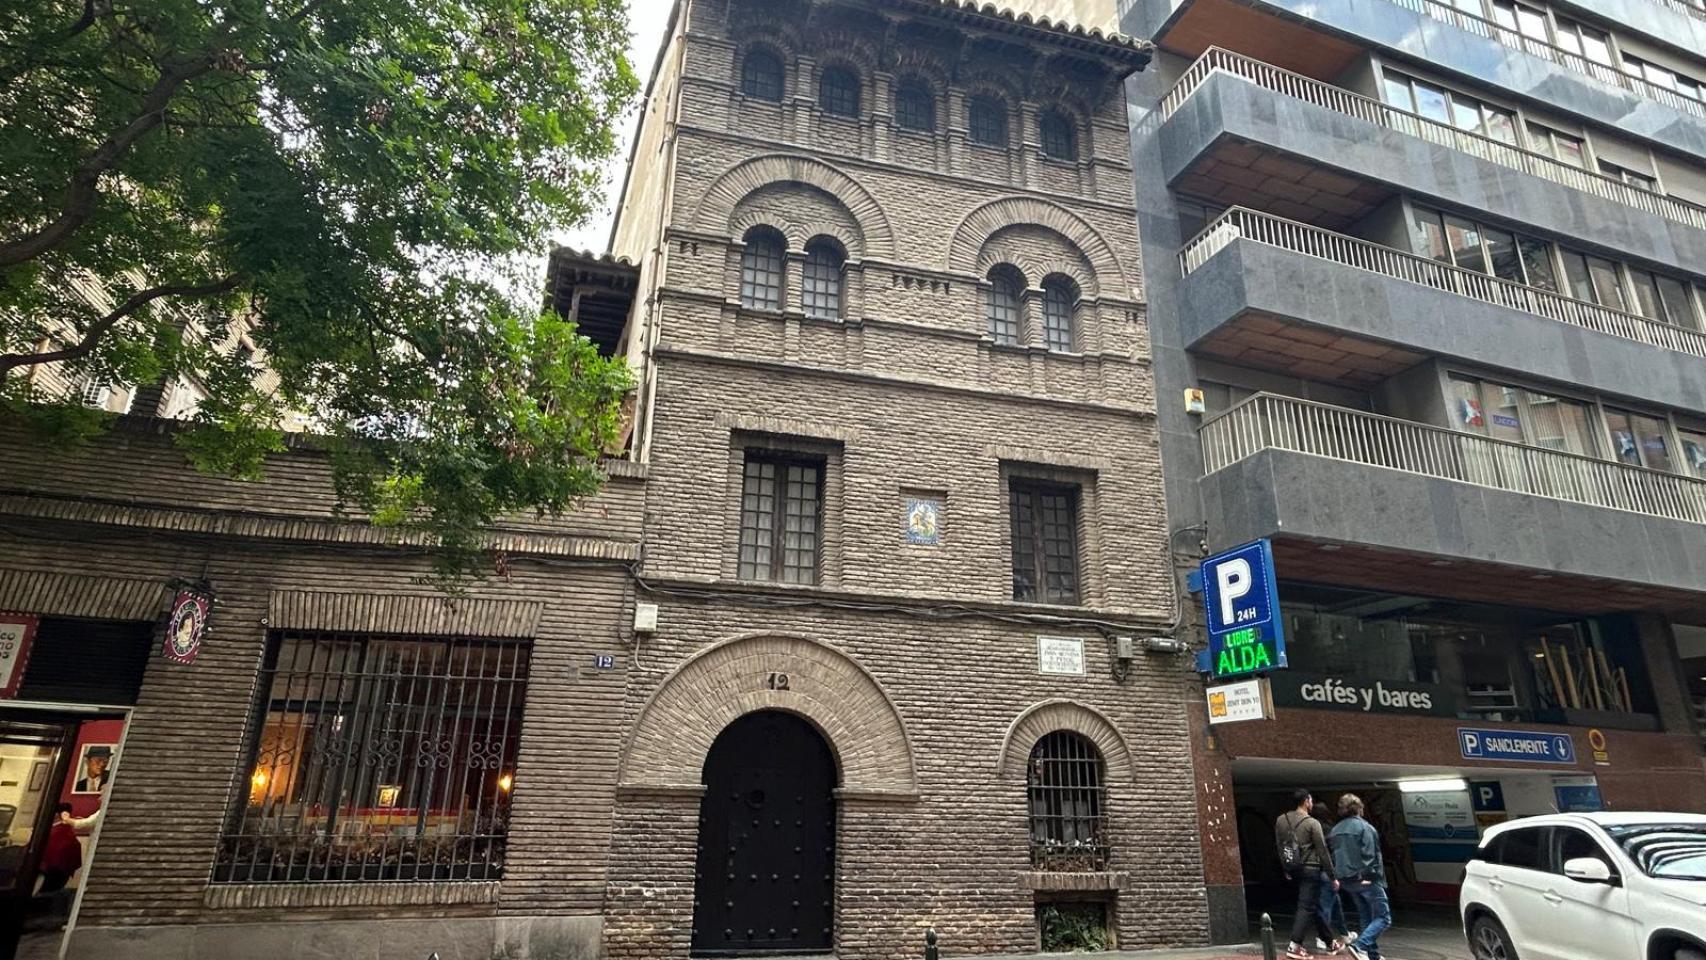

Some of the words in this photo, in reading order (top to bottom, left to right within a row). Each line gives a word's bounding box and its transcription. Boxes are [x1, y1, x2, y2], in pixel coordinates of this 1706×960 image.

[1215, 557, 1252, 626] P
[1237, 606, 1257, 623] 24H
[1225, 627, 1255, 648] LIBRE
[598, 655, 612, 667] 12
[1218, 642, 1271, 674] ALDA
[767, 672, 790, 691] 12
[1300, 678, 1358, 704] cafés
[1359, 687, 1373, 711] y
[1376, 681, 1432, 709] bares
[1464, 733, 1478, 754] P
[1485, 736, 1551, 755] SANCLEMENTE
[1480, 786, 1494, 806] P
